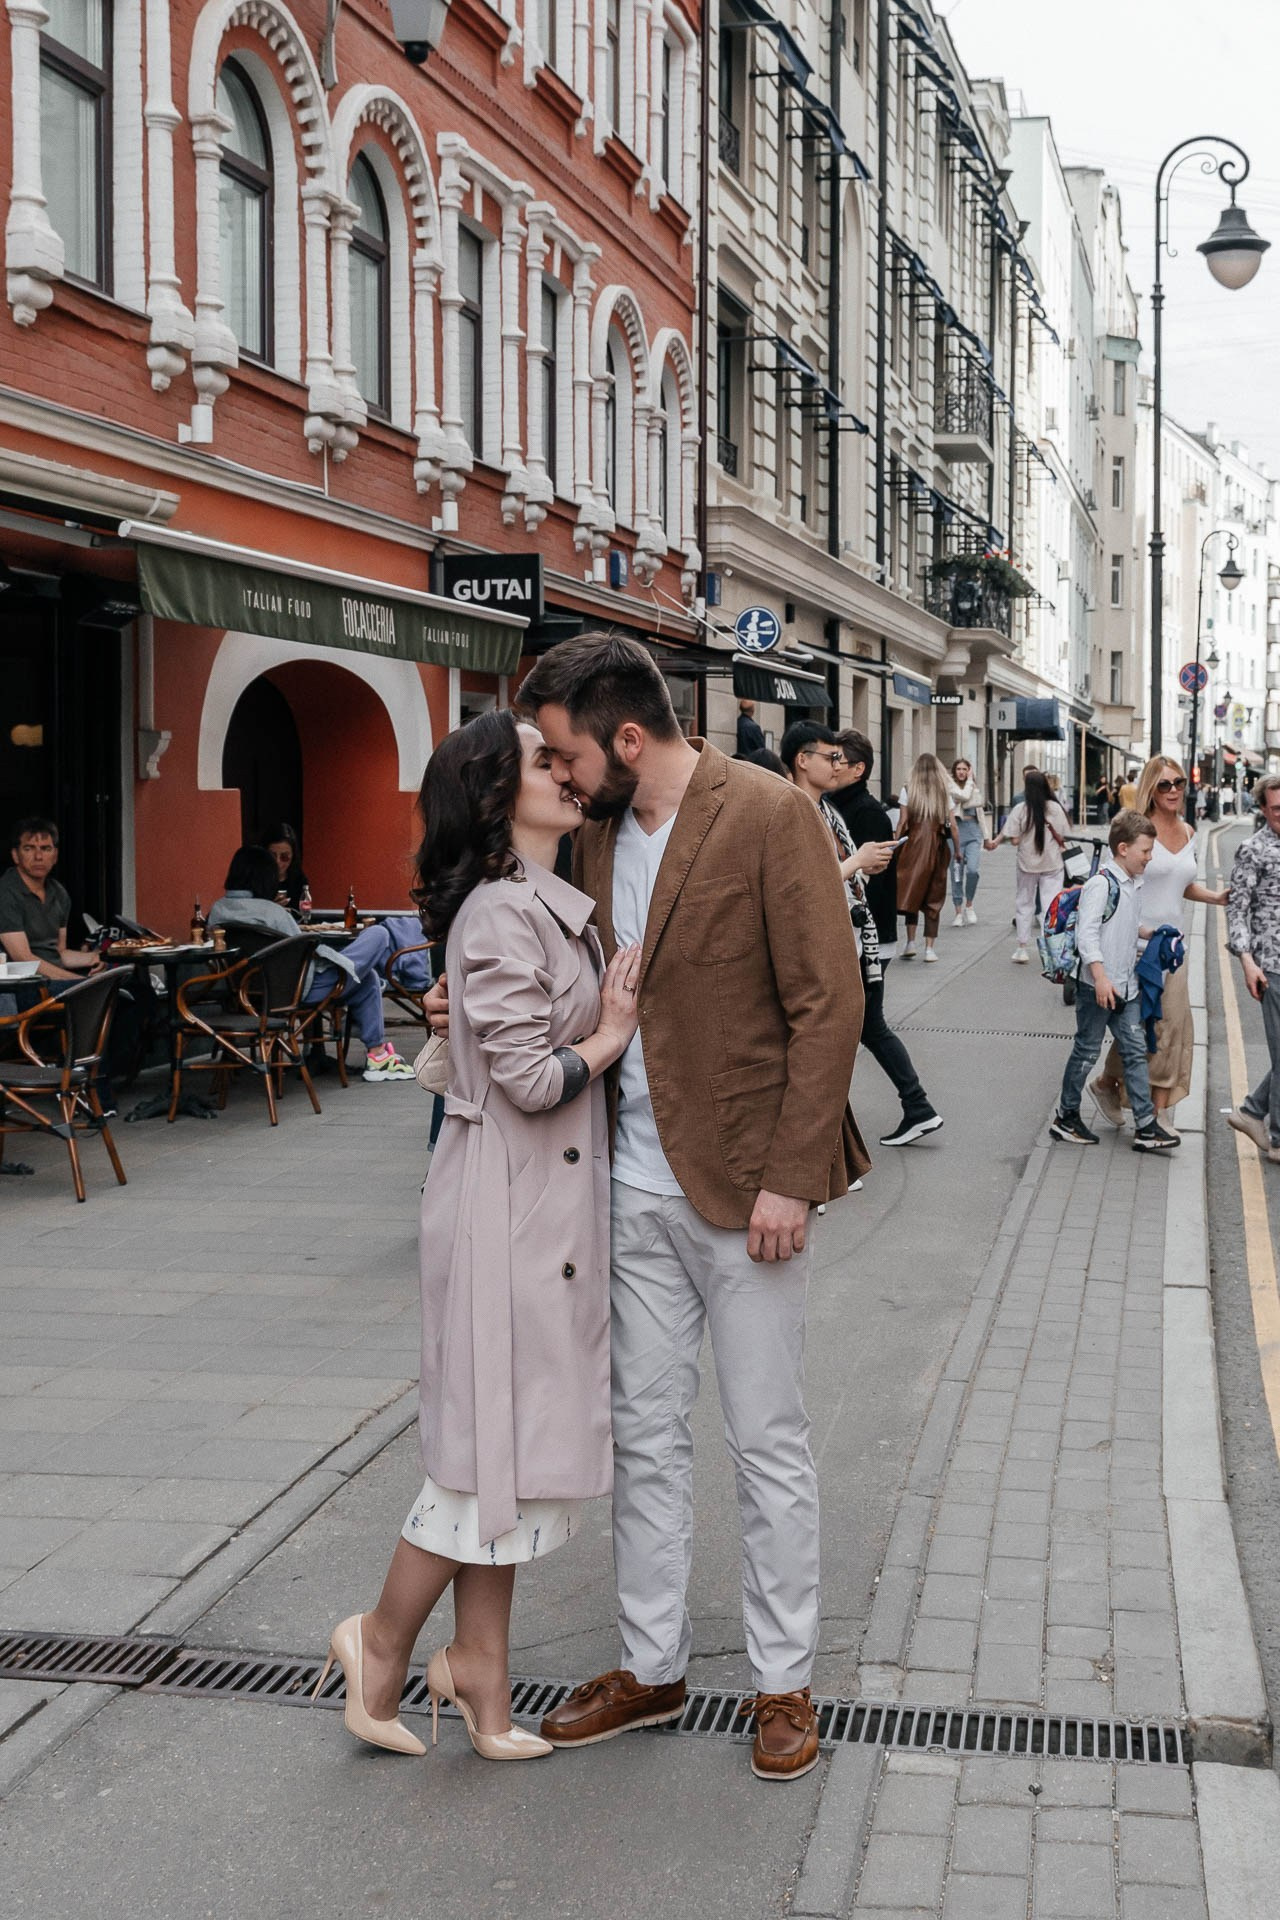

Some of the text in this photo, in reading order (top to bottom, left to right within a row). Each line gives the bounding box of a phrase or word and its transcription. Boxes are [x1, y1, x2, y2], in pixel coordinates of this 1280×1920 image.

[452, 578, 531, 600] GUTAI
[242, 589, 312, 618] ITALIAN FOOD
[342, 597, 396, 645] FOCACCERIA
[423, 626, 449, 645] TALIAN
